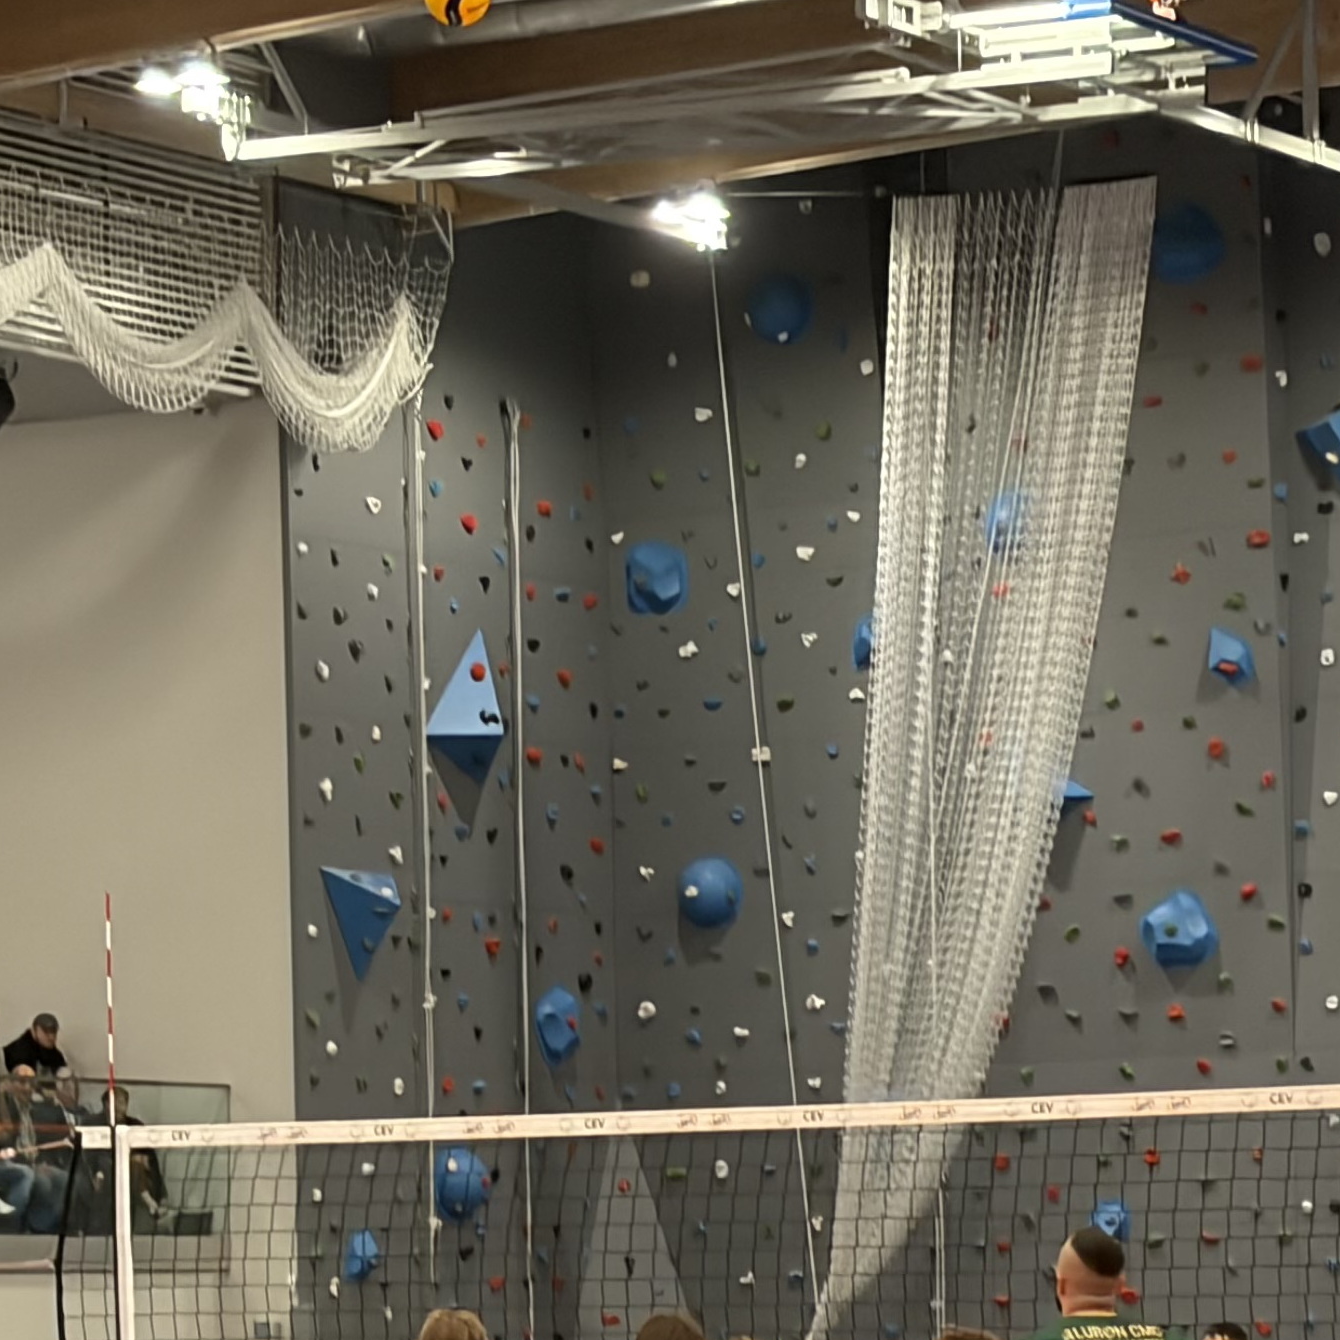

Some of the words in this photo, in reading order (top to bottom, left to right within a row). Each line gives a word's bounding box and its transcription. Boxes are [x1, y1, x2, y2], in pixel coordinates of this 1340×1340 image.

[1269, 1091, 1294, 1105] CEV
[1031, 1101, 1055, 1115] CEV
[802, 1109, 825, 1123] CEV
[583, 1117, 606, 1130] CEV
